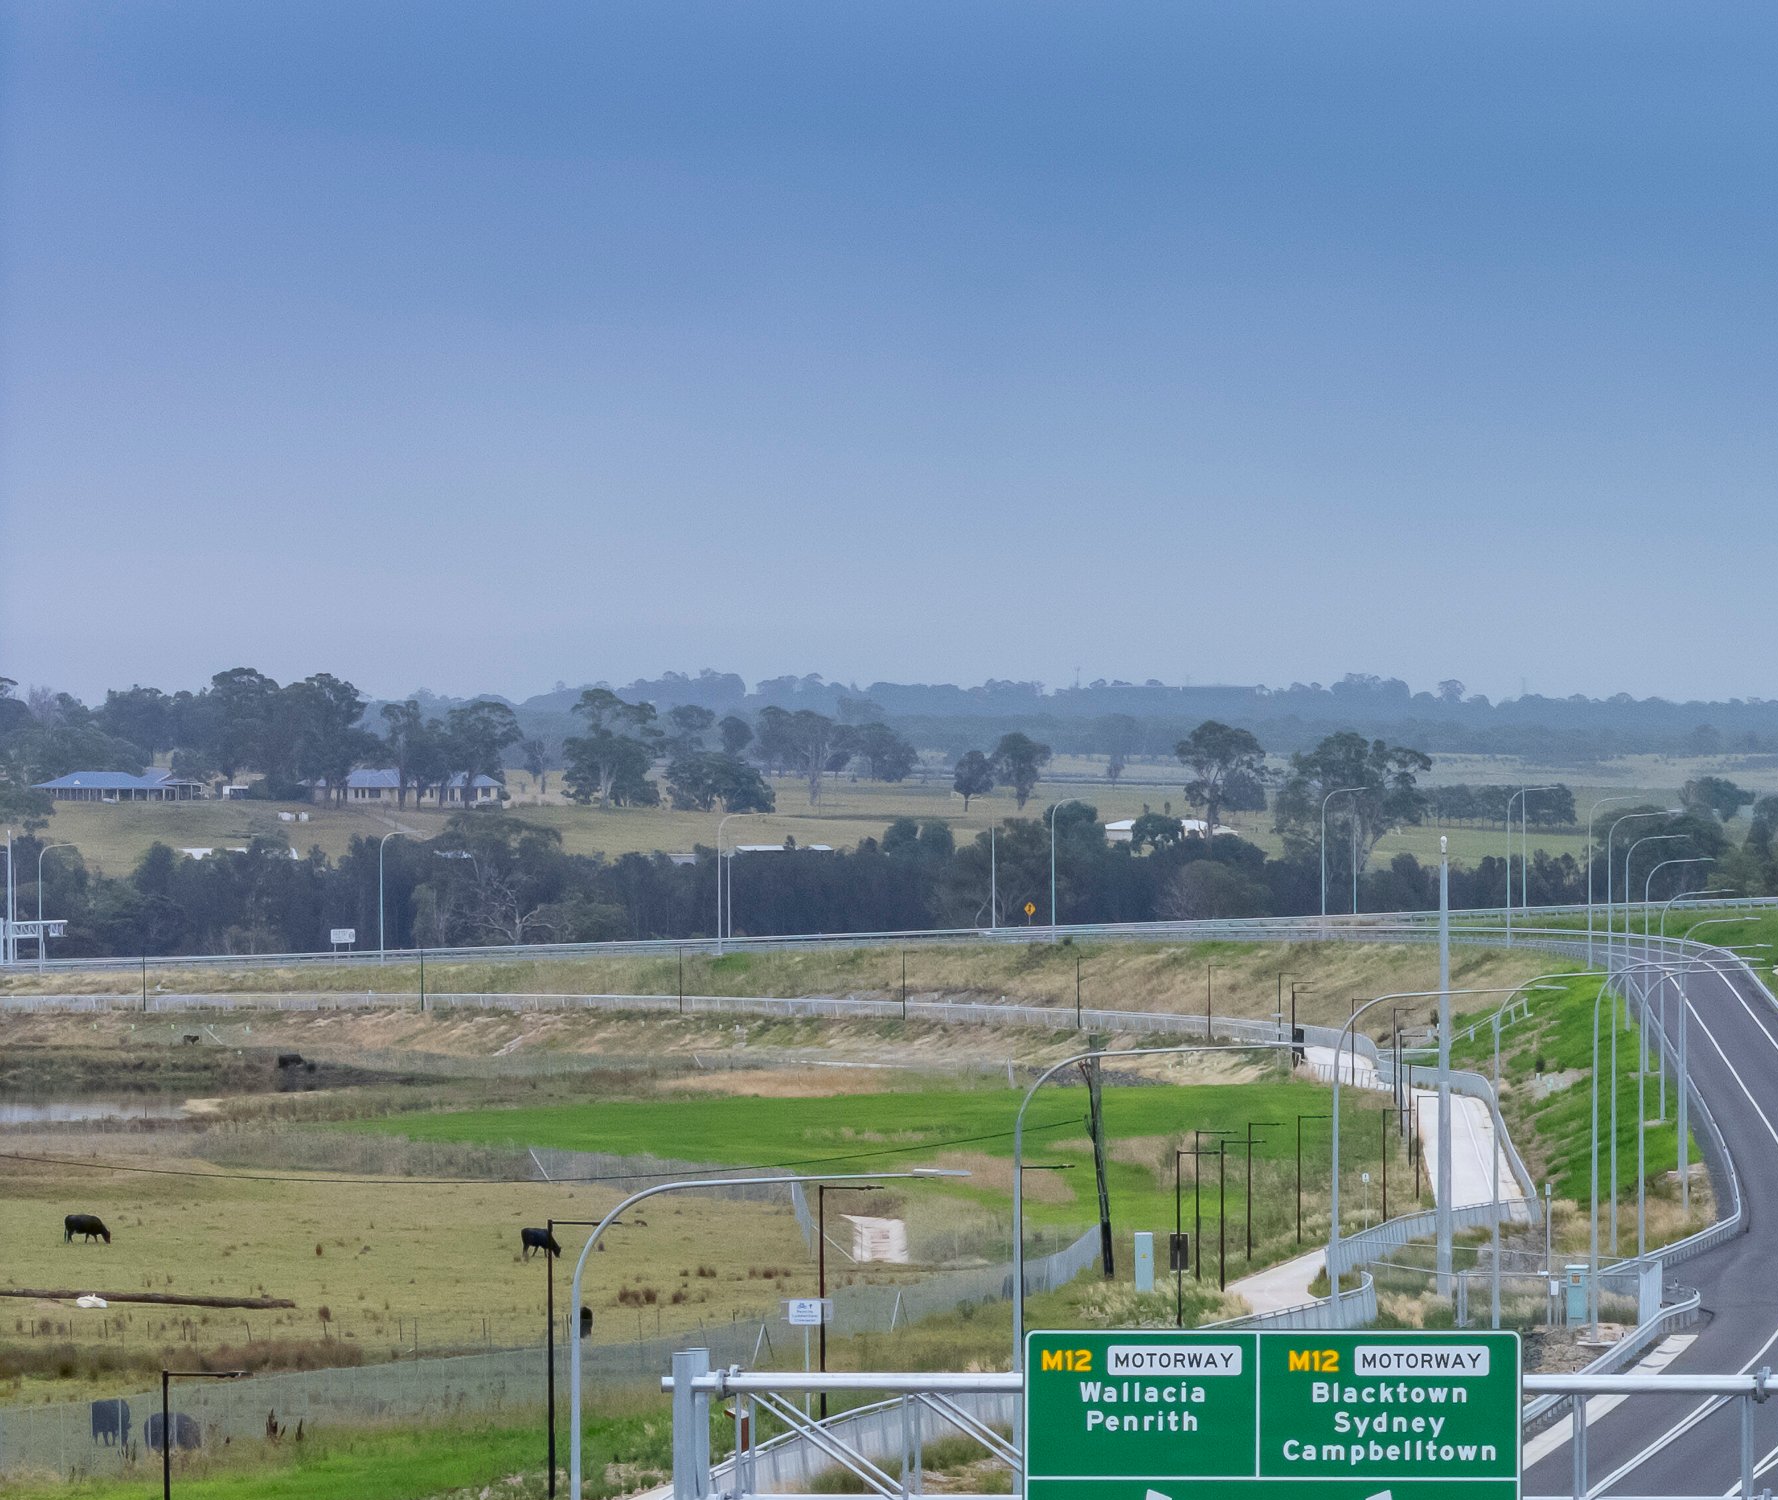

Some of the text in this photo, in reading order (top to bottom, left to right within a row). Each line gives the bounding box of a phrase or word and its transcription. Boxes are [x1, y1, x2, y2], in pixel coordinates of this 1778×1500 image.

[1042, 1349, 1234, 1372] M12 MOTORWAY
[1289, 1349, 1481, 1372] M12 MOTORWAY
[1080, 1381, 1205, 1403] Wallacia
[1312, 1382, 1467, 1403] Blacktown
[1087, 1410, 1198, 1432] Penrith
[1334, 1411, 1445, 1438] Sydney
[1283, 1440, 1496, 1465] Campbelltown
